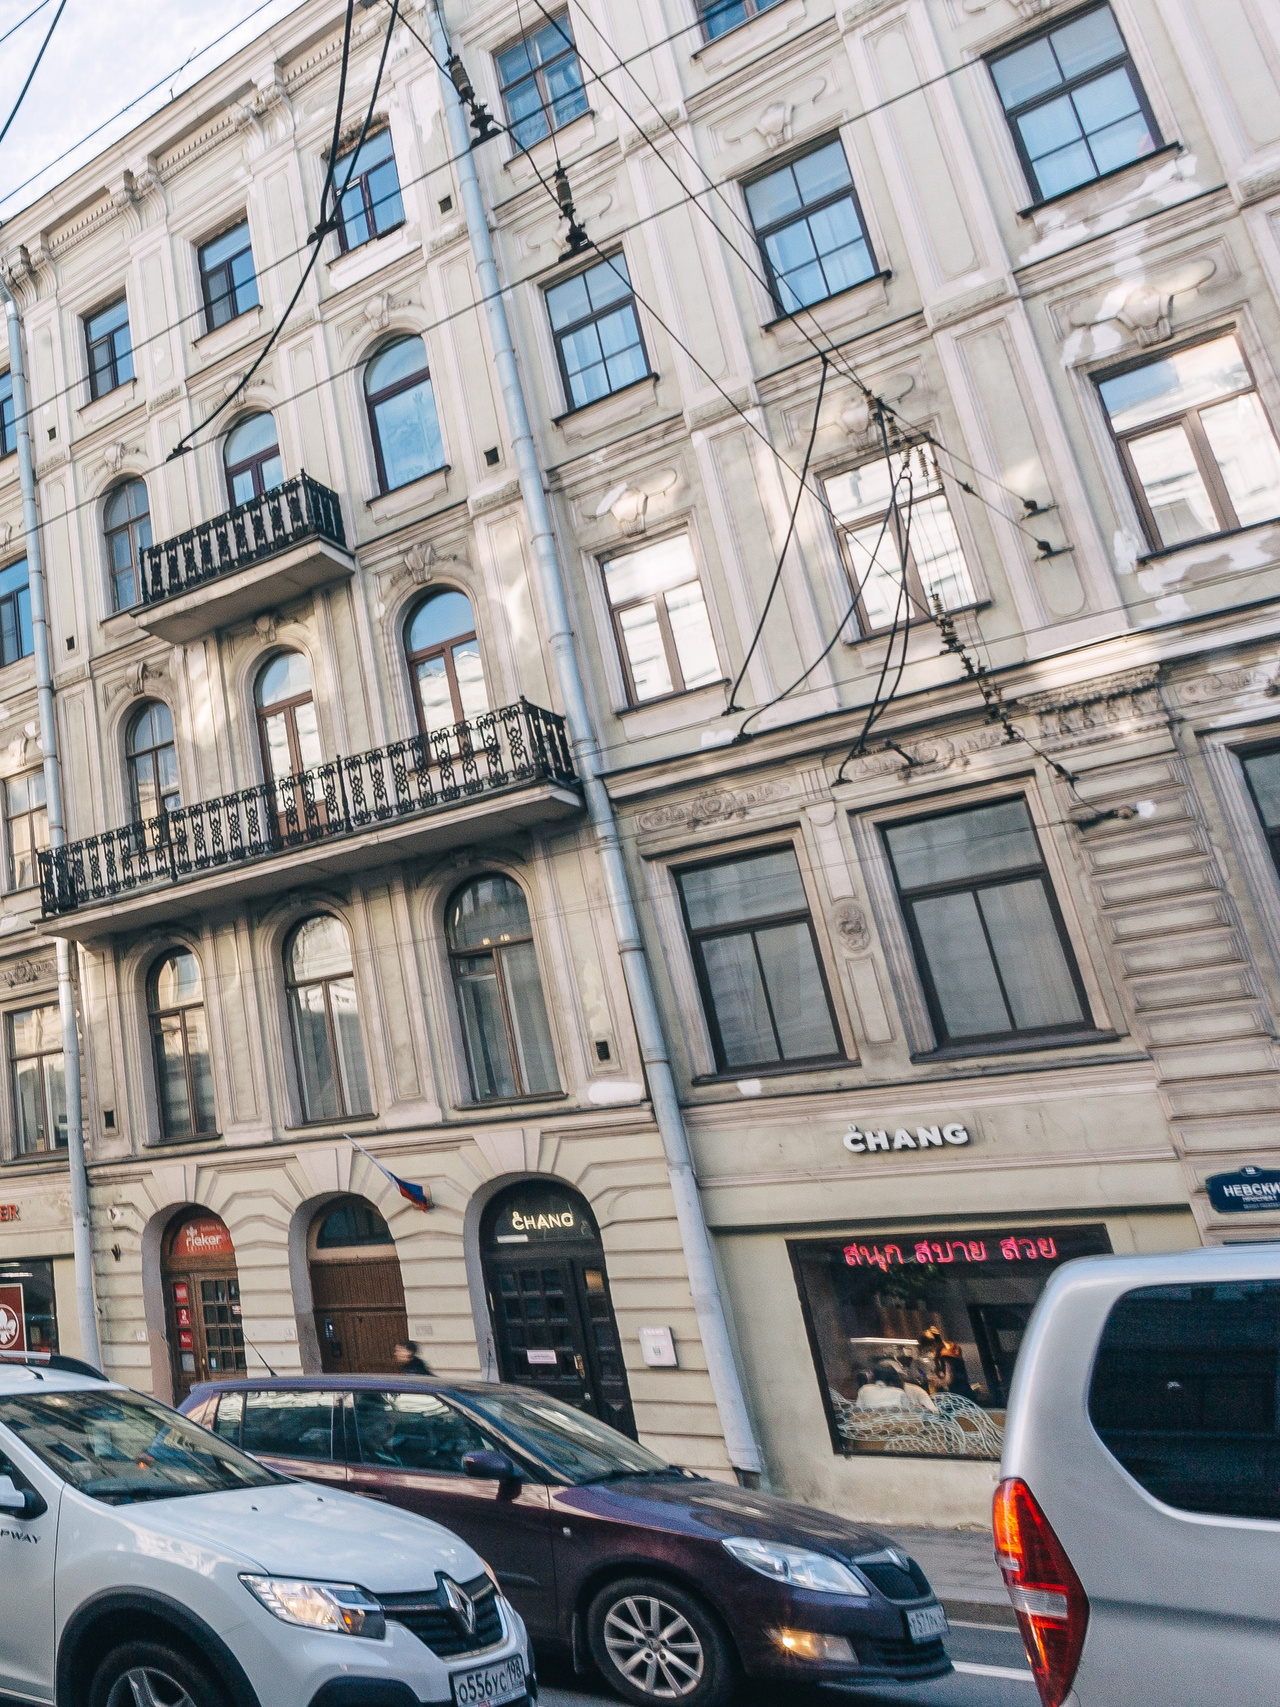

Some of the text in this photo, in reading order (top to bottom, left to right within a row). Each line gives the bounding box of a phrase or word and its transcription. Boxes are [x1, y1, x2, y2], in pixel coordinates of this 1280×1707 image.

[185, 1232, 222, 1247] rieker
[914, 1240, 988, 1264] สบาย
[1000, 1236, 1059, 1260] สวย
